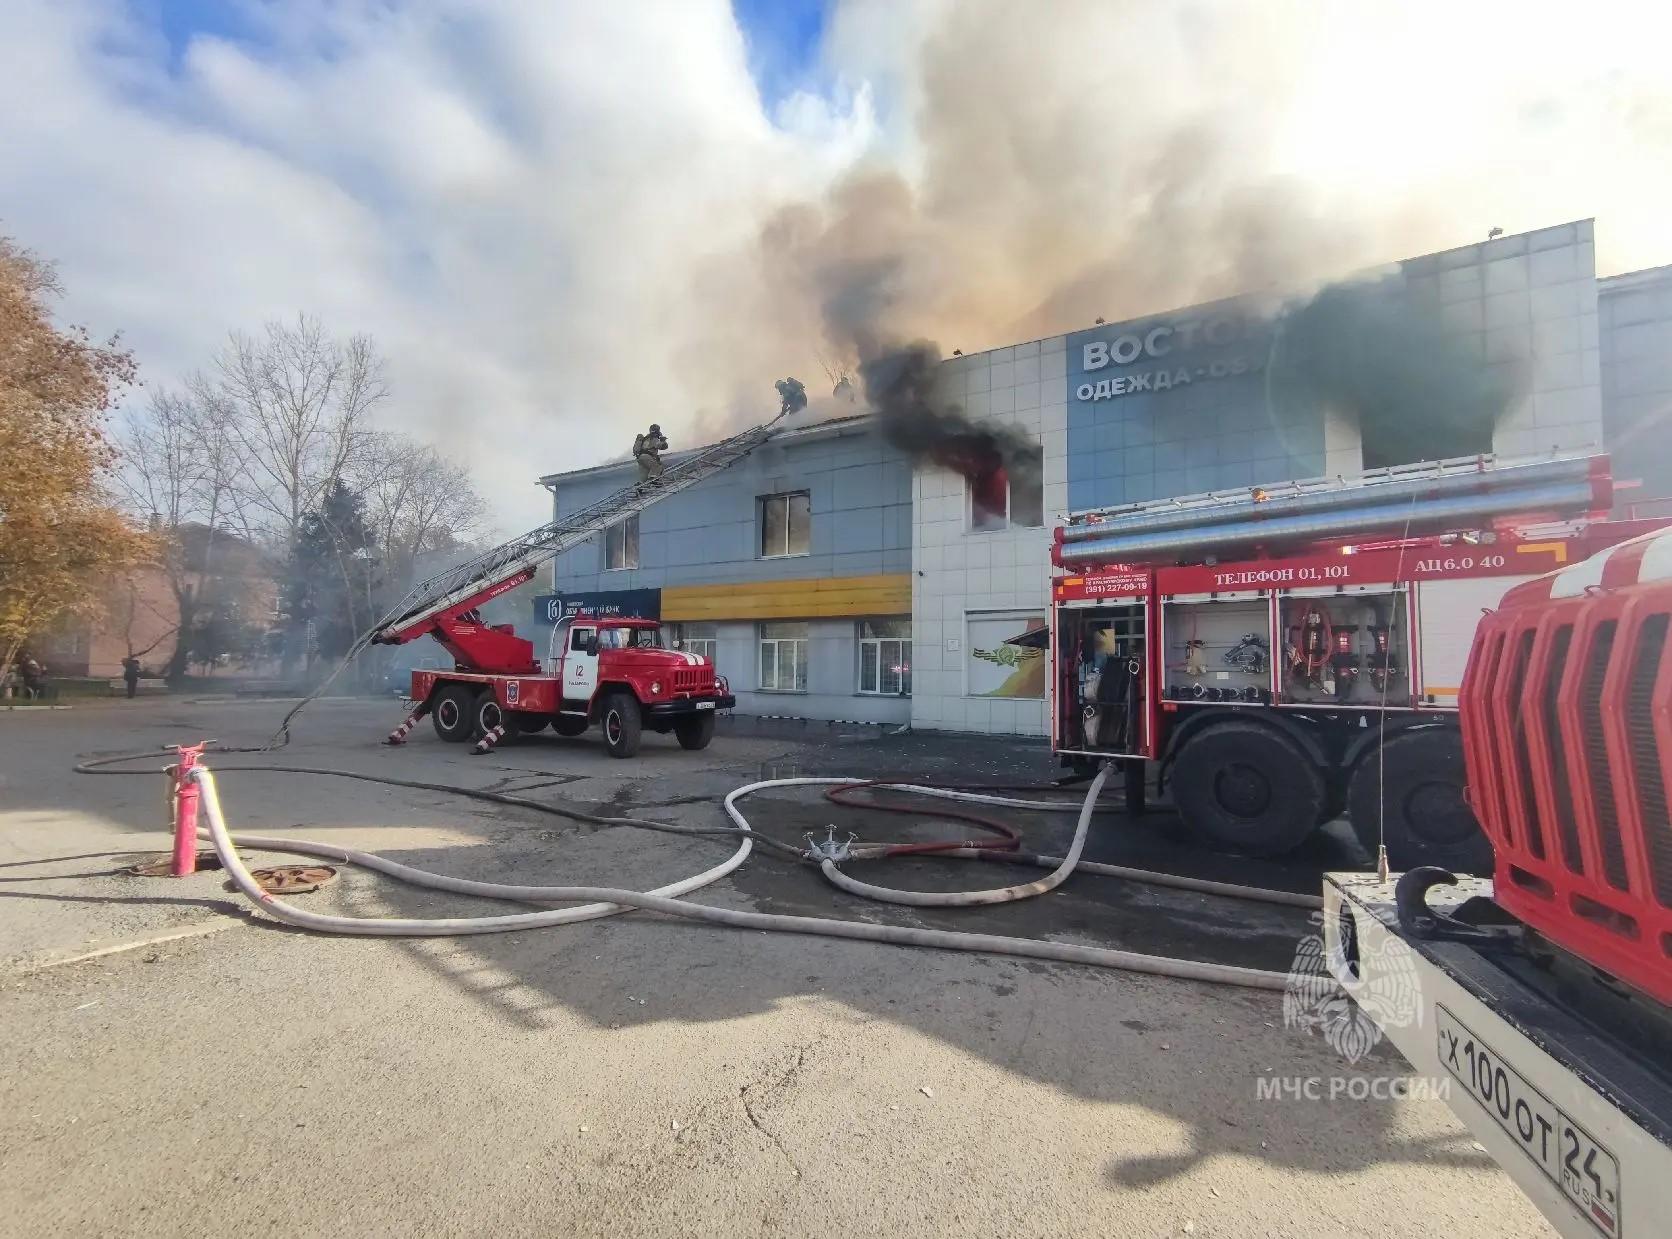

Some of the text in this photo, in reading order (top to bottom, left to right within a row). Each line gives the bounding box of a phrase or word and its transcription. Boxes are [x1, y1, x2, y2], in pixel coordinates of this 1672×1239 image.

[1083, 319, 1235, 372] ВОСТО
[1479, 555, 1505, 568] 40
[1215, 568, 1294, 586] ТЕЛЕФОН
[1085, 585, 1106, 595] (391)
[574, 664, 584, 677] 12
[1564, 1127, 1601, 1197] 24
[1563, 1167, 1592, 1205] RUS
